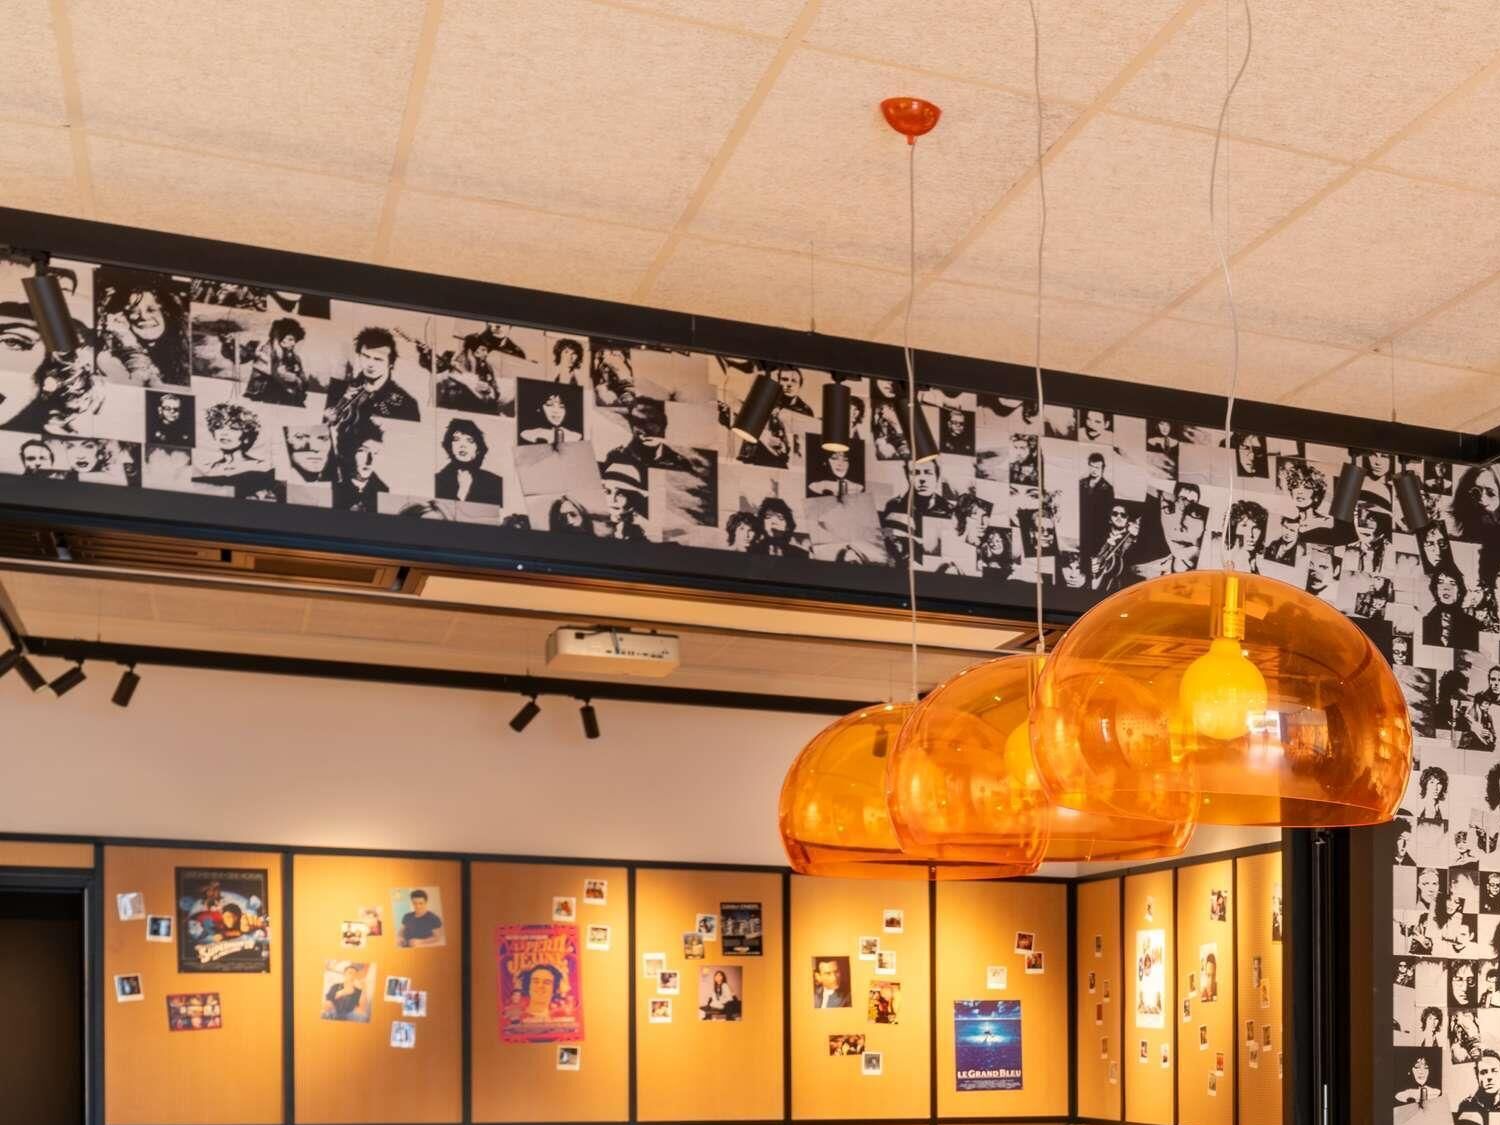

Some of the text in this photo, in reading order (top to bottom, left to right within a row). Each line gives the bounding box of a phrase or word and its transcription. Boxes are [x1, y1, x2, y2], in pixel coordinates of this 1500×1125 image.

[957, 1068, 1022, 1079] LE GRAND BLEU
